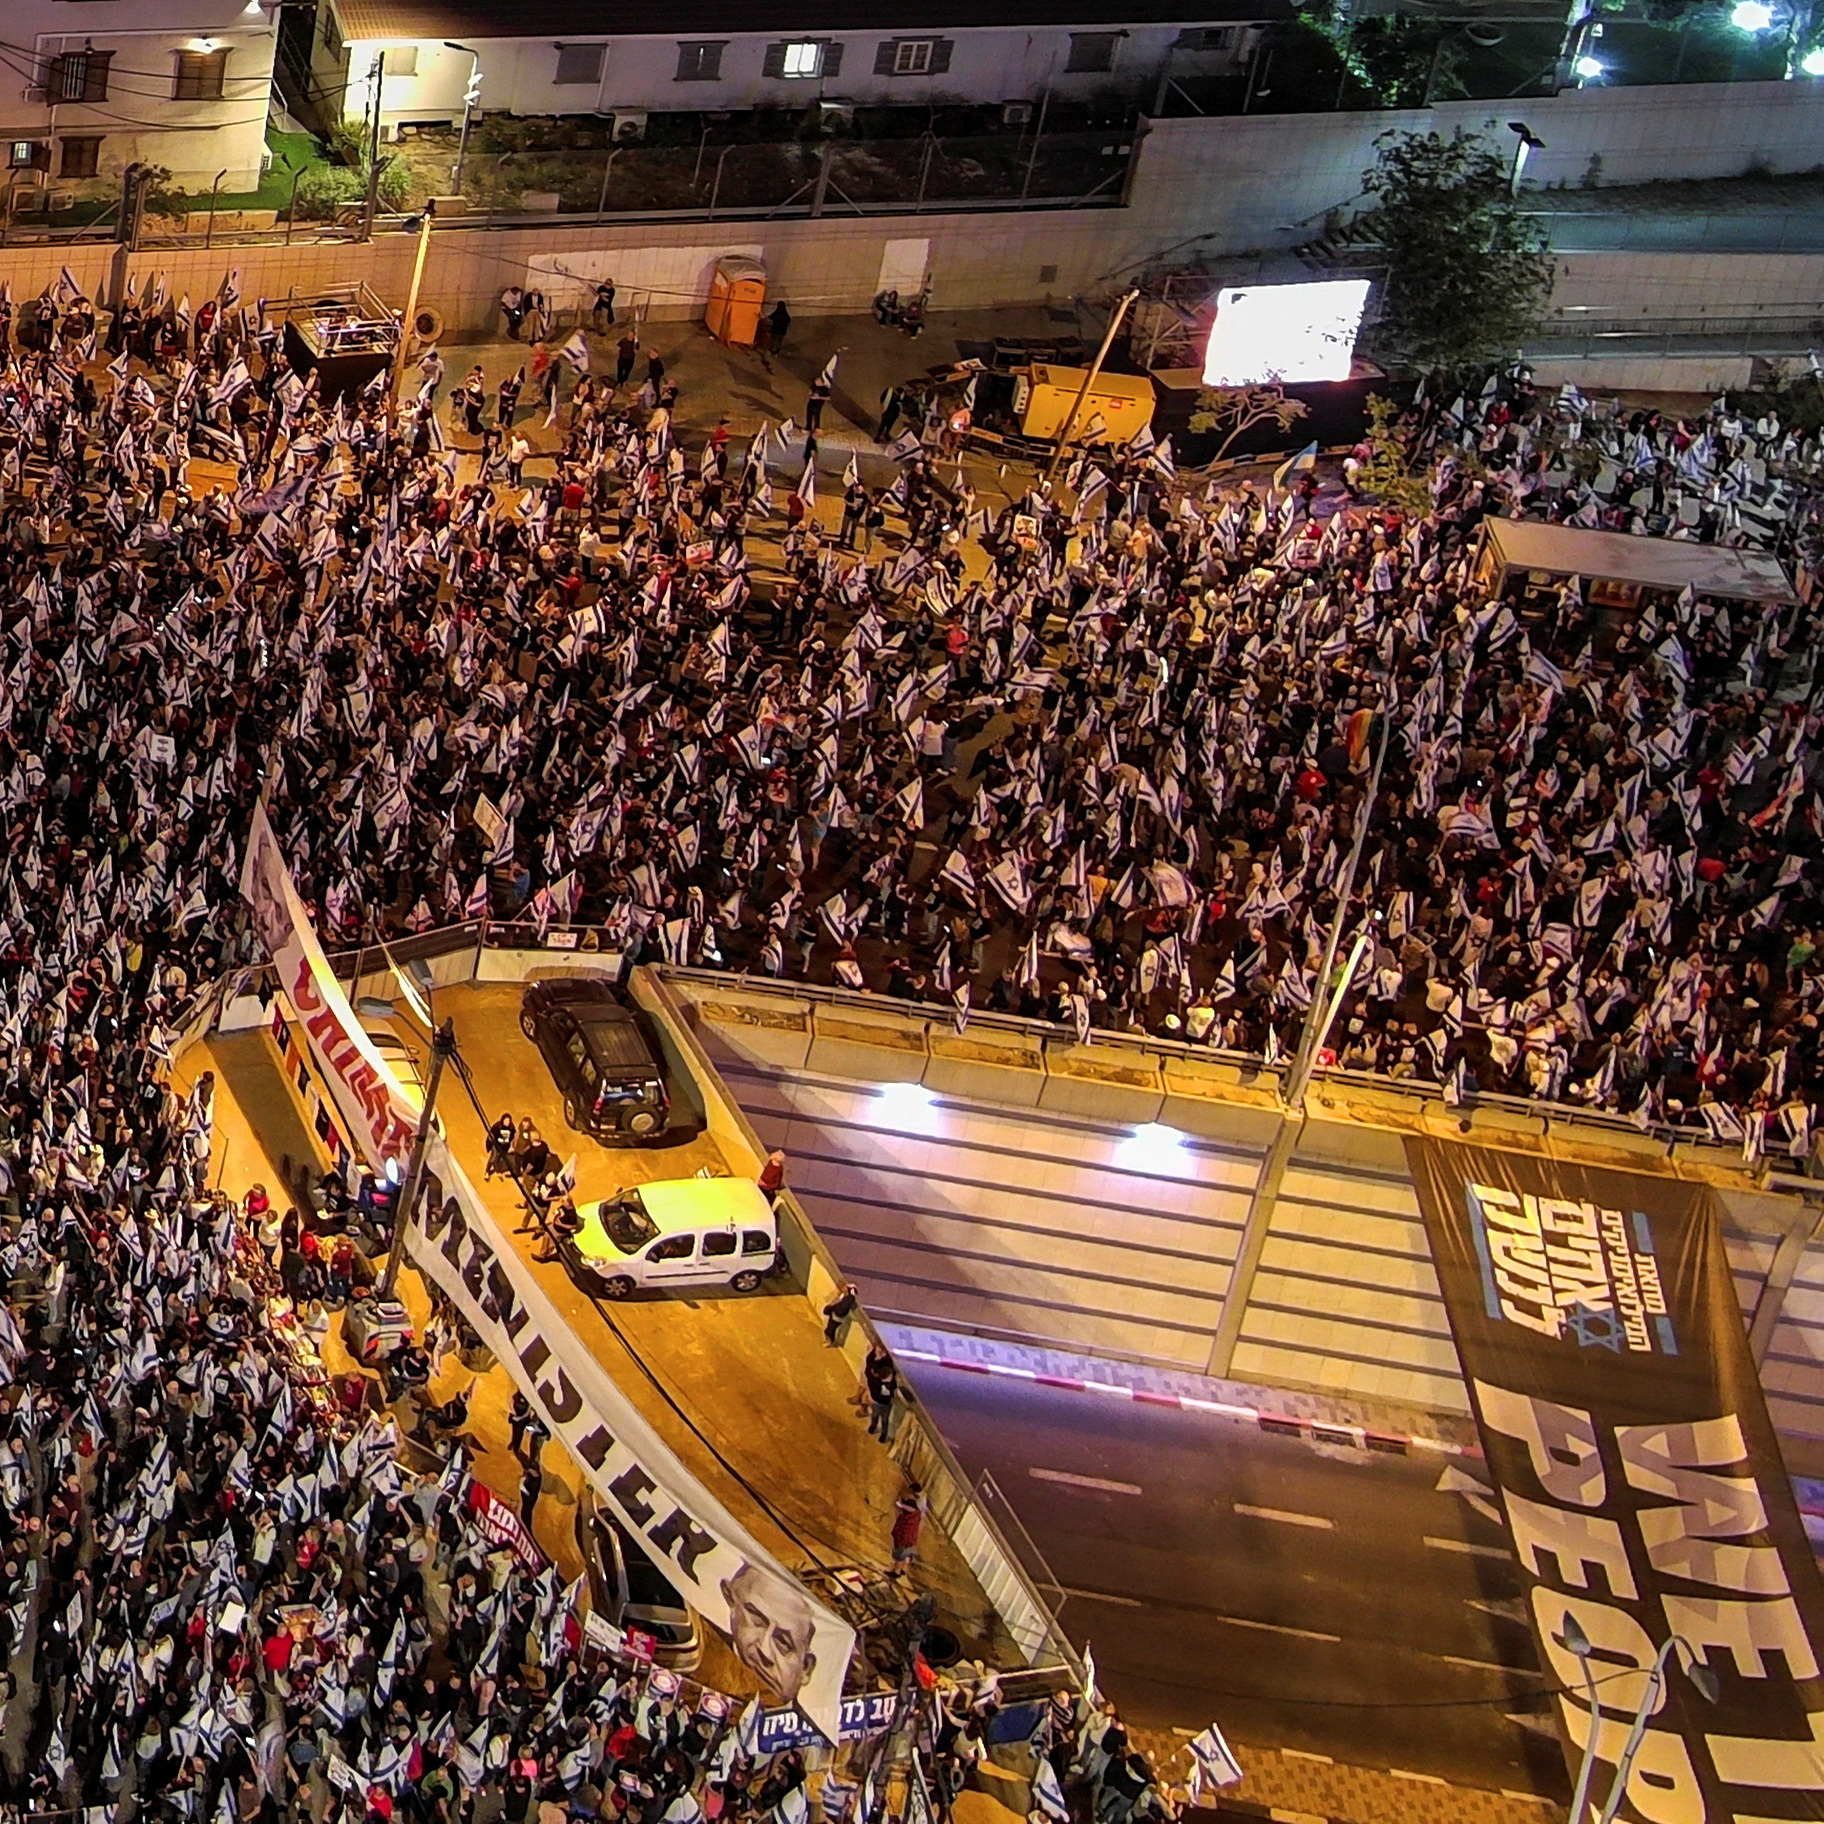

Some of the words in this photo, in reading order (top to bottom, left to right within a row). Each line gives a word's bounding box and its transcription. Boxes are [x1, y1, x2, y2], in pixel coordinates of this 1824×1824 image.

[293, 955, 414, 1159] CRIME
[410, 1161, 718, 1588] MINISTER
[1472, 1183, 1567, 1341] לנשק
[1538, 1196, 1614, 1310] אחים
[1601, 1209, 1652, 1352] המילואימניקים
[1634, 1253, 1667, 1314] מחאת
[1473, 1377, 1706, 1824] PEOP
[1614, 1414, 1820, 1680] WE
